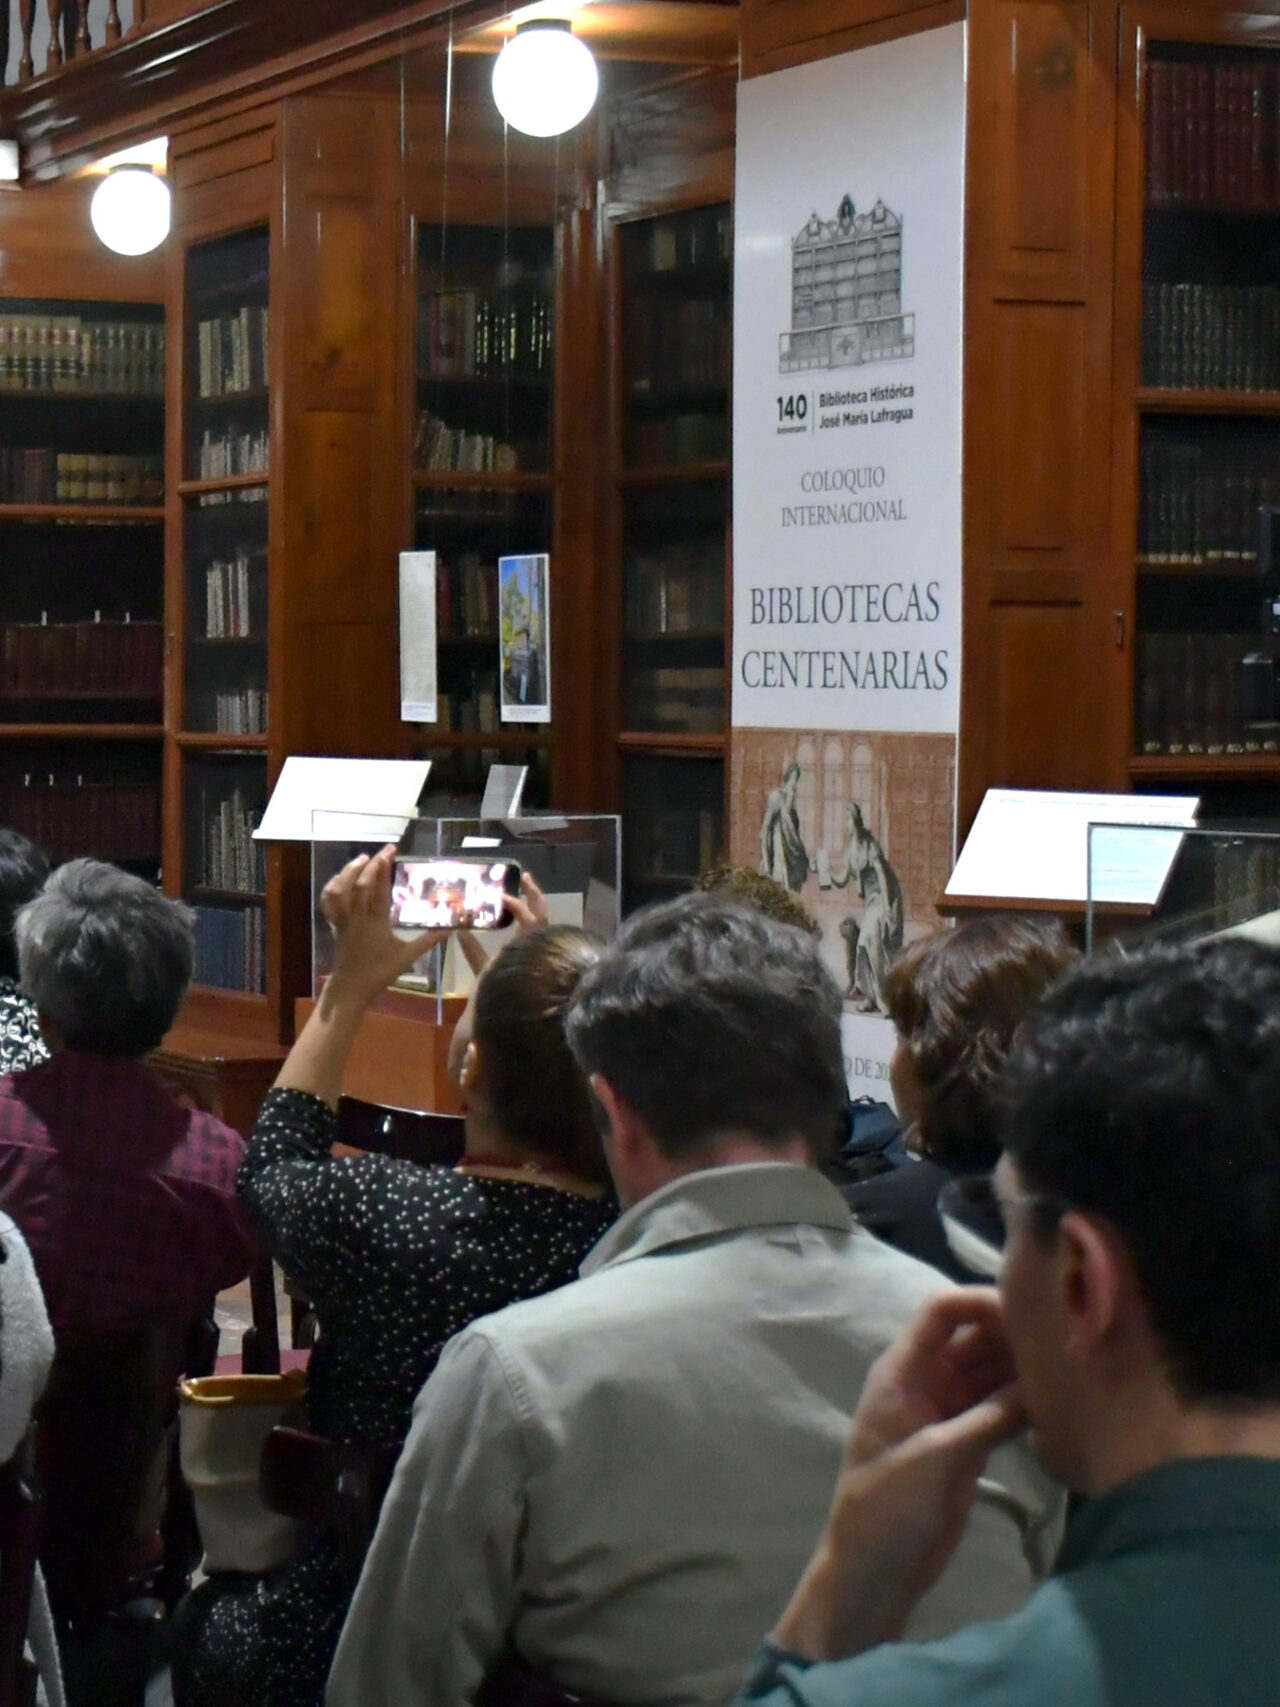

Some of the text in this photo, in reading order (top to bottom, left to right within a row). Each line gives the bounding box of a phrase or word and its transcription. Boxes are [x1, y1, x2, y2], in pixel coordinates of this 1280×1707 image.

[776, 393, 808, 422] 140
[819, 383, 915, 408] Biblioteca Histórica
[819, 411, 841, 430] José
[870, 407, 914, 424] Lafragua
[800, 465, 886, 495] COLOQUIO
[781, 498, 908, 528] INTERNACIONAL
[749, 581, 941, 625] BIBLIOTECAS
[740, 649, 949, 691] CENTENARIAS
[854, 1056, 873, 1079] DE
